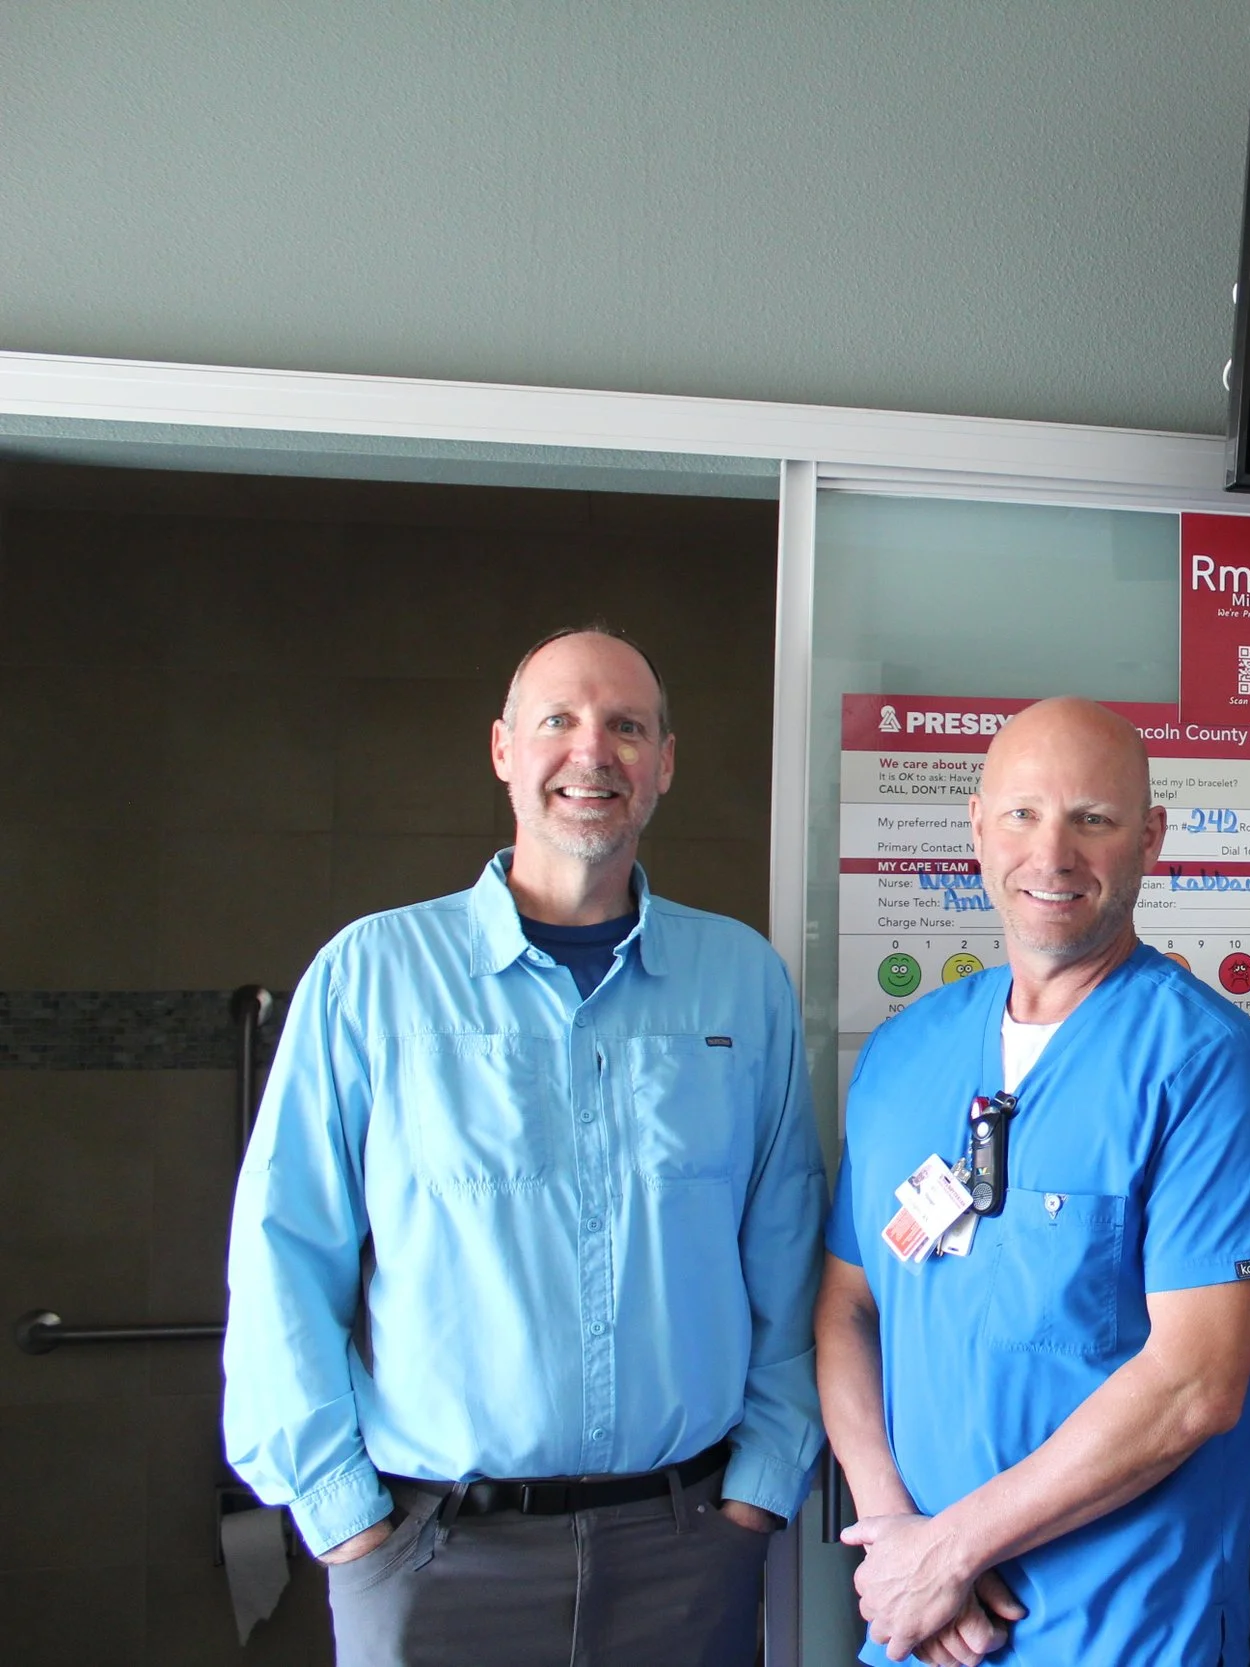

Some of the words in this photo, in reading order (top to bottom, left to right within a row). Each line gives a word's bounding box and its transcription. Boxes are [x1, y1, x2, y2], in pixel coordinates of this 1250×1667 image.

[1217, 608, 1239, 618] We're
[1229, 697, 1248, 705] Scan
[906, 711, 1014, 735] PRESBY
[1136, 724, 1180, 740] ncoln
[1186, 725, 1247, 746] County
[879, 758, 899, 769] We
[903, 760, 928, 769] care
[932, 759, 967, 770] about
[879, 772, 886, 781] It
[888, 772, 896, 781] is
[898, 773, 914, 781] OK
[916, 774, 926, 782] to
[928, 774, 946, 782] ask:
[949, 774, 973, 783] Have
[1170, 780, 1183, 789] my
[1186, 778, 1196, 787] ID
[1198, 778, 1238, 788] bracelet?
[878, 785, 908, 795] CALL,
[911, 785, 947, 795] DON'T
[1153, 790, 1178, 800] help!
[878, 817, 894, 829] My
[897, 817, 947, 830] preferred
[950, 820, 972, 828] nam
[1187, 808, 1239, 834] 242
[878, 842, 917, 856] Primary
[921, 842, 962, 853] Contact
[1221, 846, 1240, 856] Dial
[878, 862, 897, 872] MY
[900, 862, 931, 872] CARE
[935, 862, 968, 872] TEAM
[878, 878, 912, 888] Nurse:
[878, 898, 910, 908] Nurse
[914, 897, 940, 908] Tech:
[1137, 899, 1177, 909] dinator:
[878, 917, 916, 929] Charge
[920, 917, 954, 928] Nurse:
[892, 940, 899, 949] 0
[926, 940, 931, 948] 1
[961, 940, 968, 949] 2
[994, 940, 1000, 949] 3
[1167, 940, 1174, 949] 8
[1198, 940, 1204, 949] 9
[1230, 940, 1241, 949] 10
